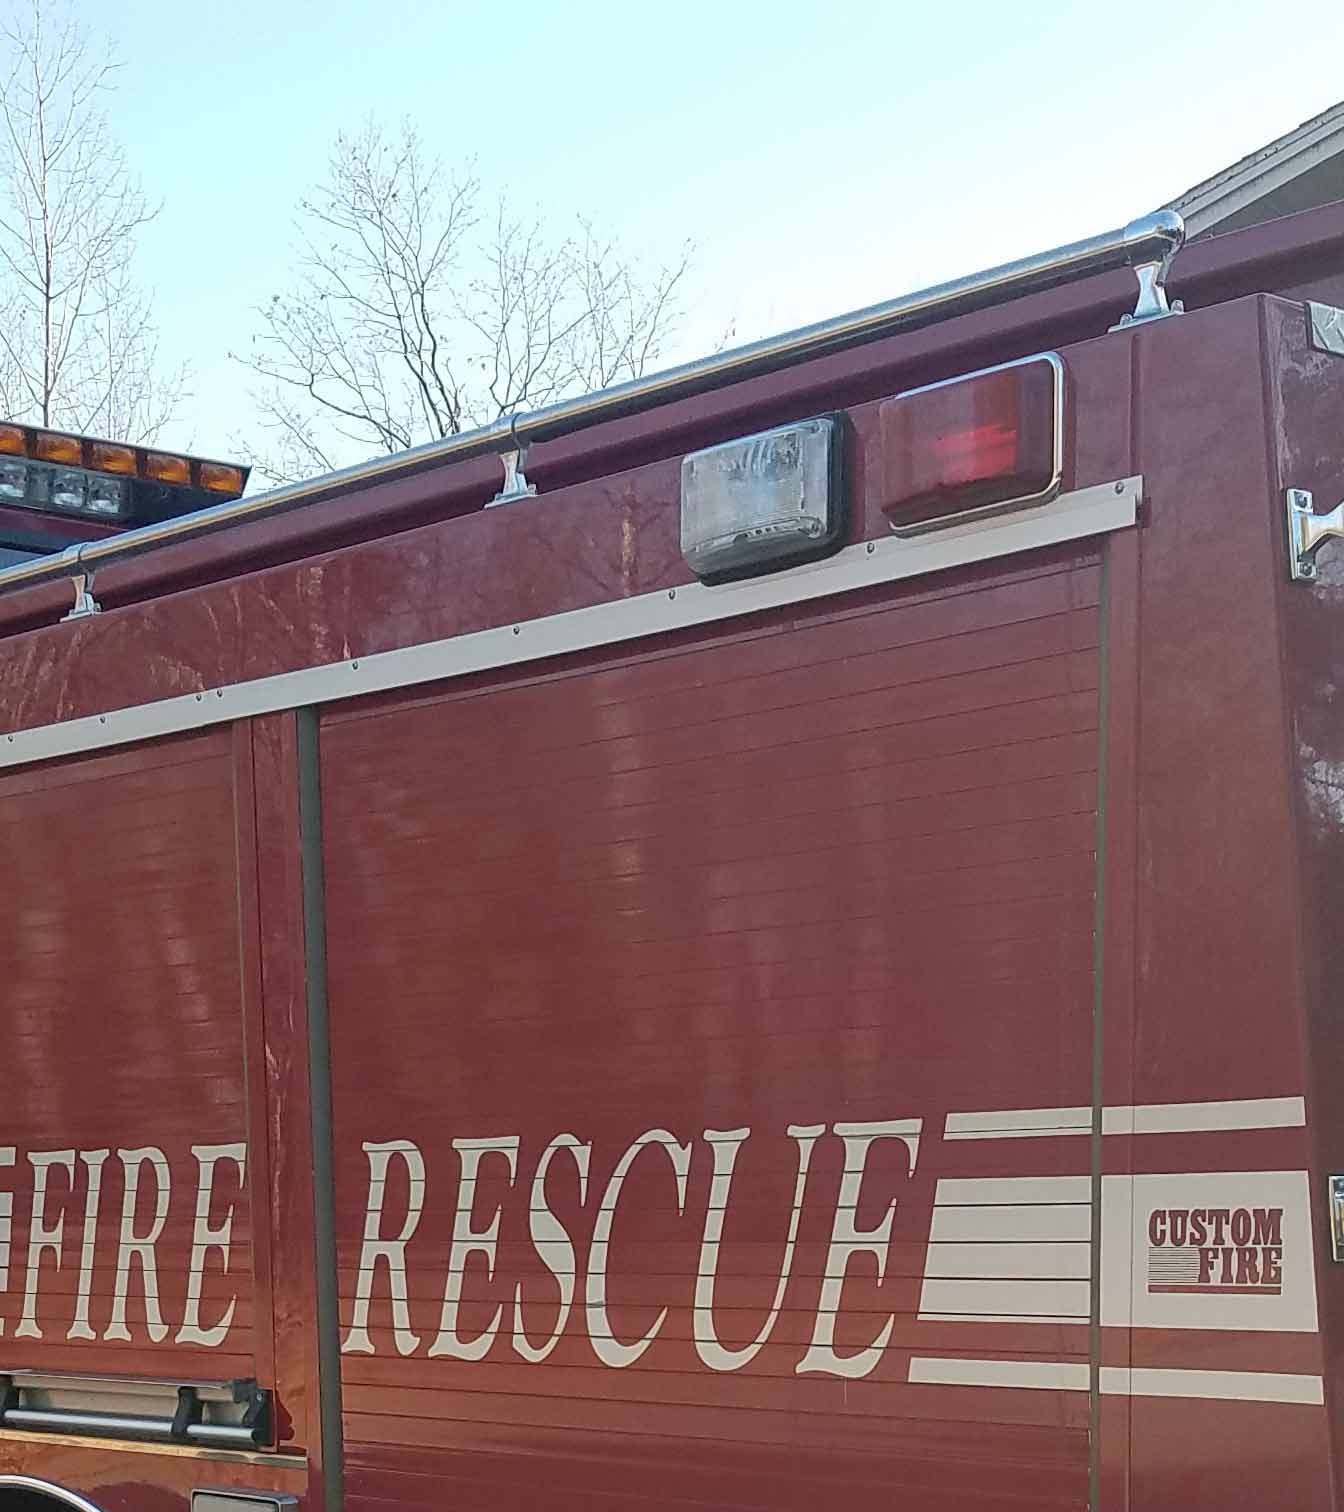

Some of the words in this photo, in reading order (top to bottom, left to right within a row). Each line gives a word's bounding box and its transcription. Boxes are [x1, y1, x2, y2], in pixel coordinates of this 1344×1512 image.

[1148, 1208, 1284, 1247] CUSTOM
[14, 1142, 247, 1347] FIRE
[341, 1117, 923, 1379] RESCUE
[1198, 1247, 1283, 1285] FIRE
